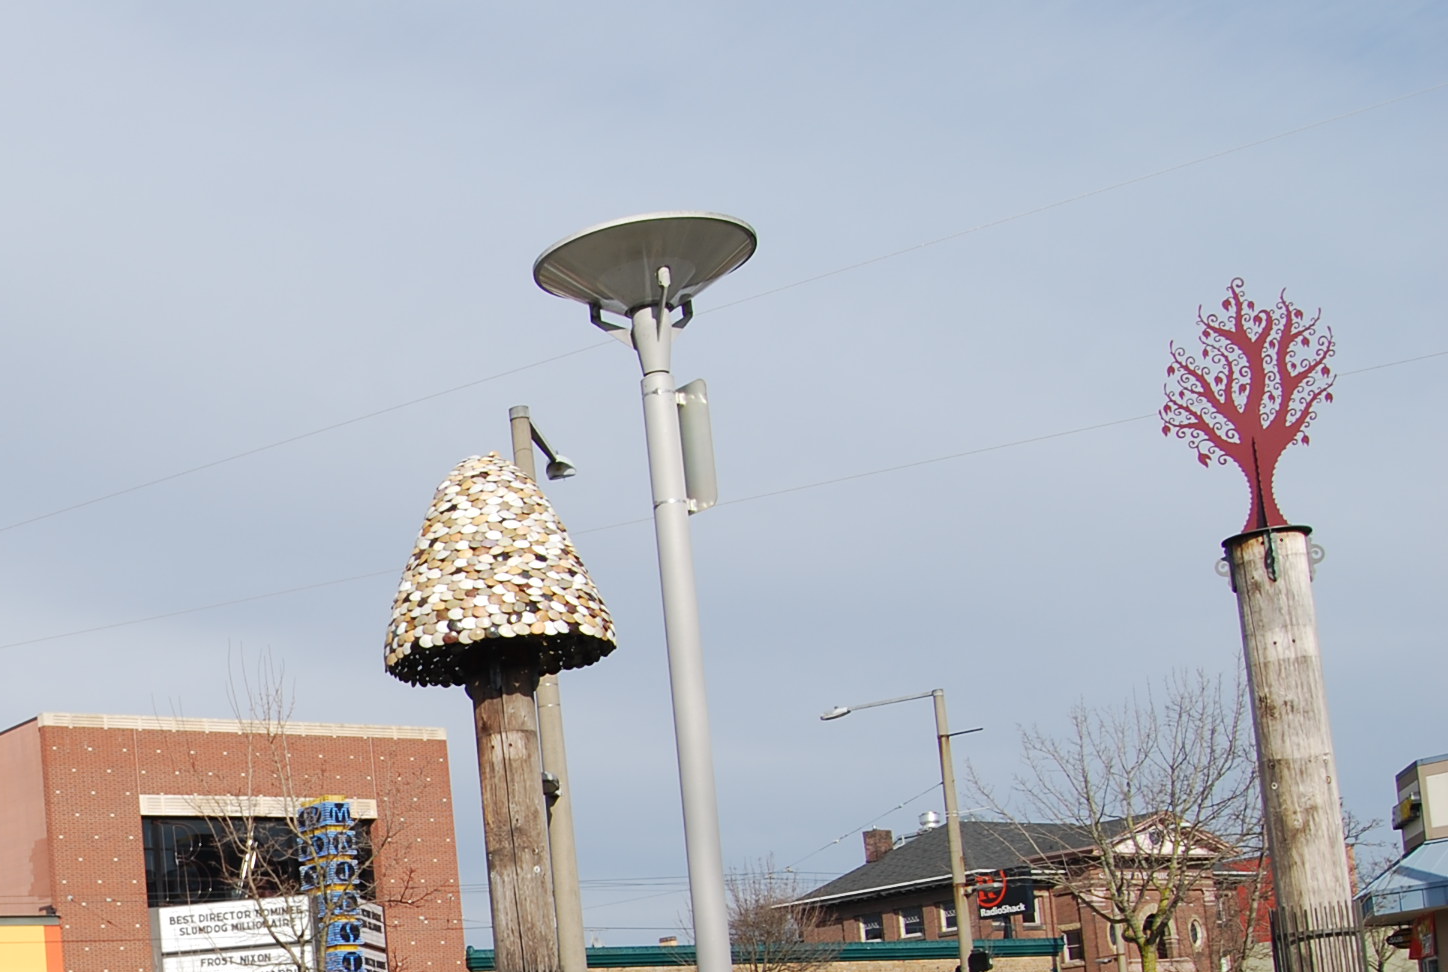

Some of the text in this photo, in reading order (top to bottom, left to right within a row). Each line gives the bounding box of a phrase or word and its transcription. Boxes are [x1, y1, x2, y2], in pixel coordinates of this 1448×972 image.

[169, 905, 302, 926] BEST DIRECTOR NOMINEE
[980, 903, 1026, 917] RadioShack
[179, 918, 296, 936] SLUMDOG MILLIOAIRE
[200, 953, 271, 967] FROST NIXON
